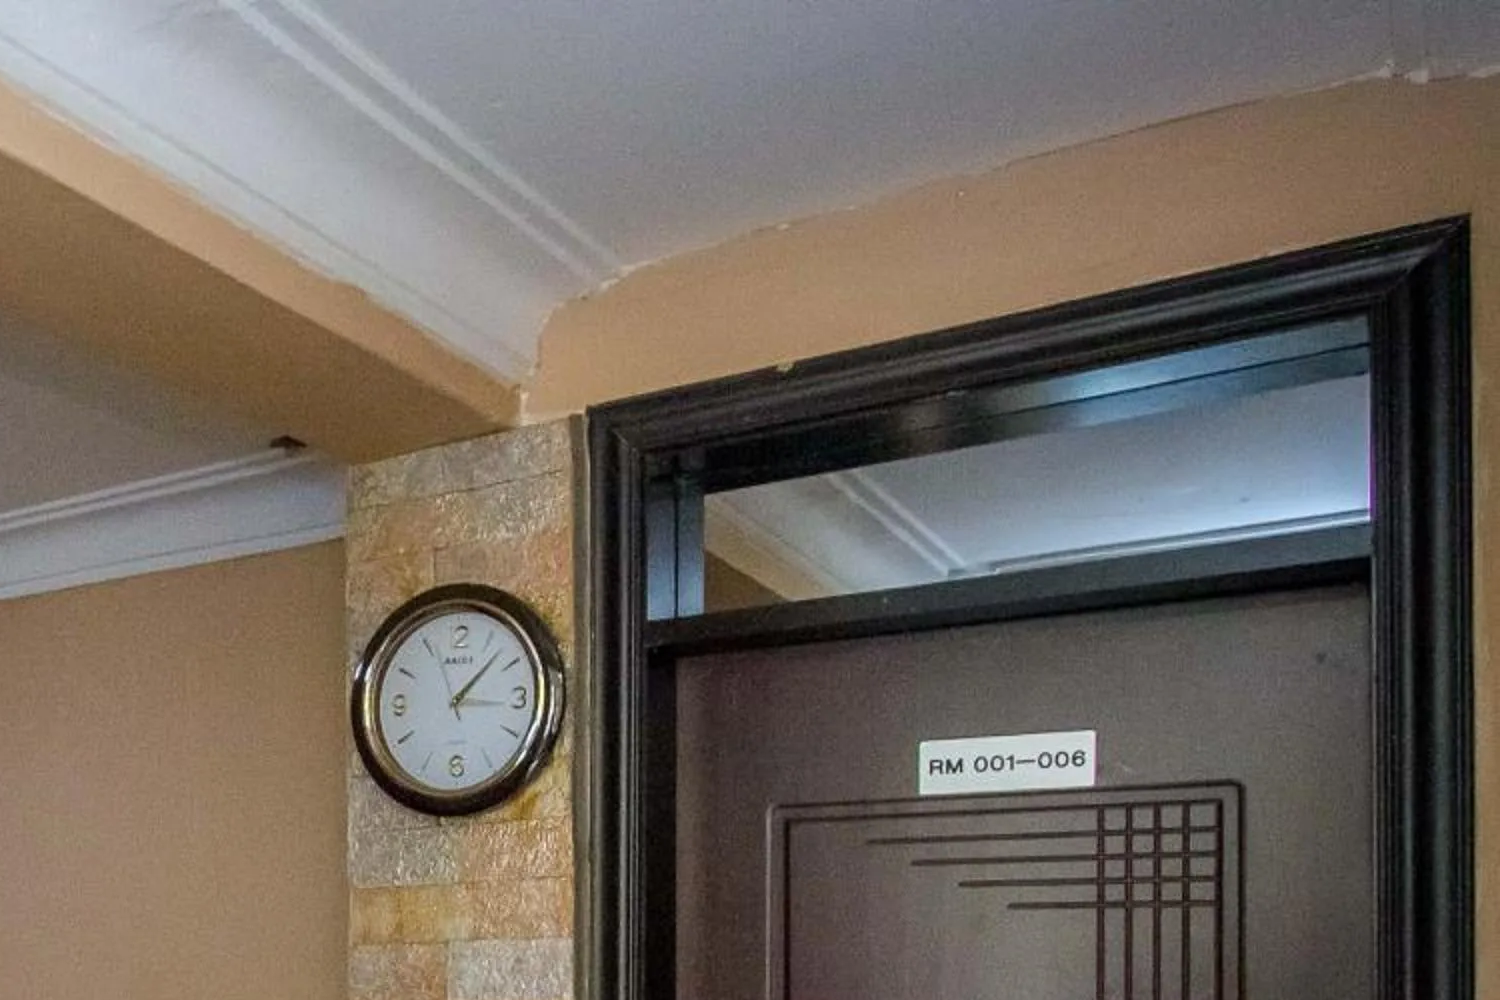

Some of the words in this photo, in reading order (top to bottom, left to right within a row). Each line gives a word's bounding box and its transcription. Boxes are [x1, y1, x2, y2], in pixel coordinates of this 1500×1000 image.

[512, 686, 527, 709] 3
[449, 755, 465, 778] 6
[929, 759, 964, 775] RM
[973, 750, 1086, 773] 001-006
